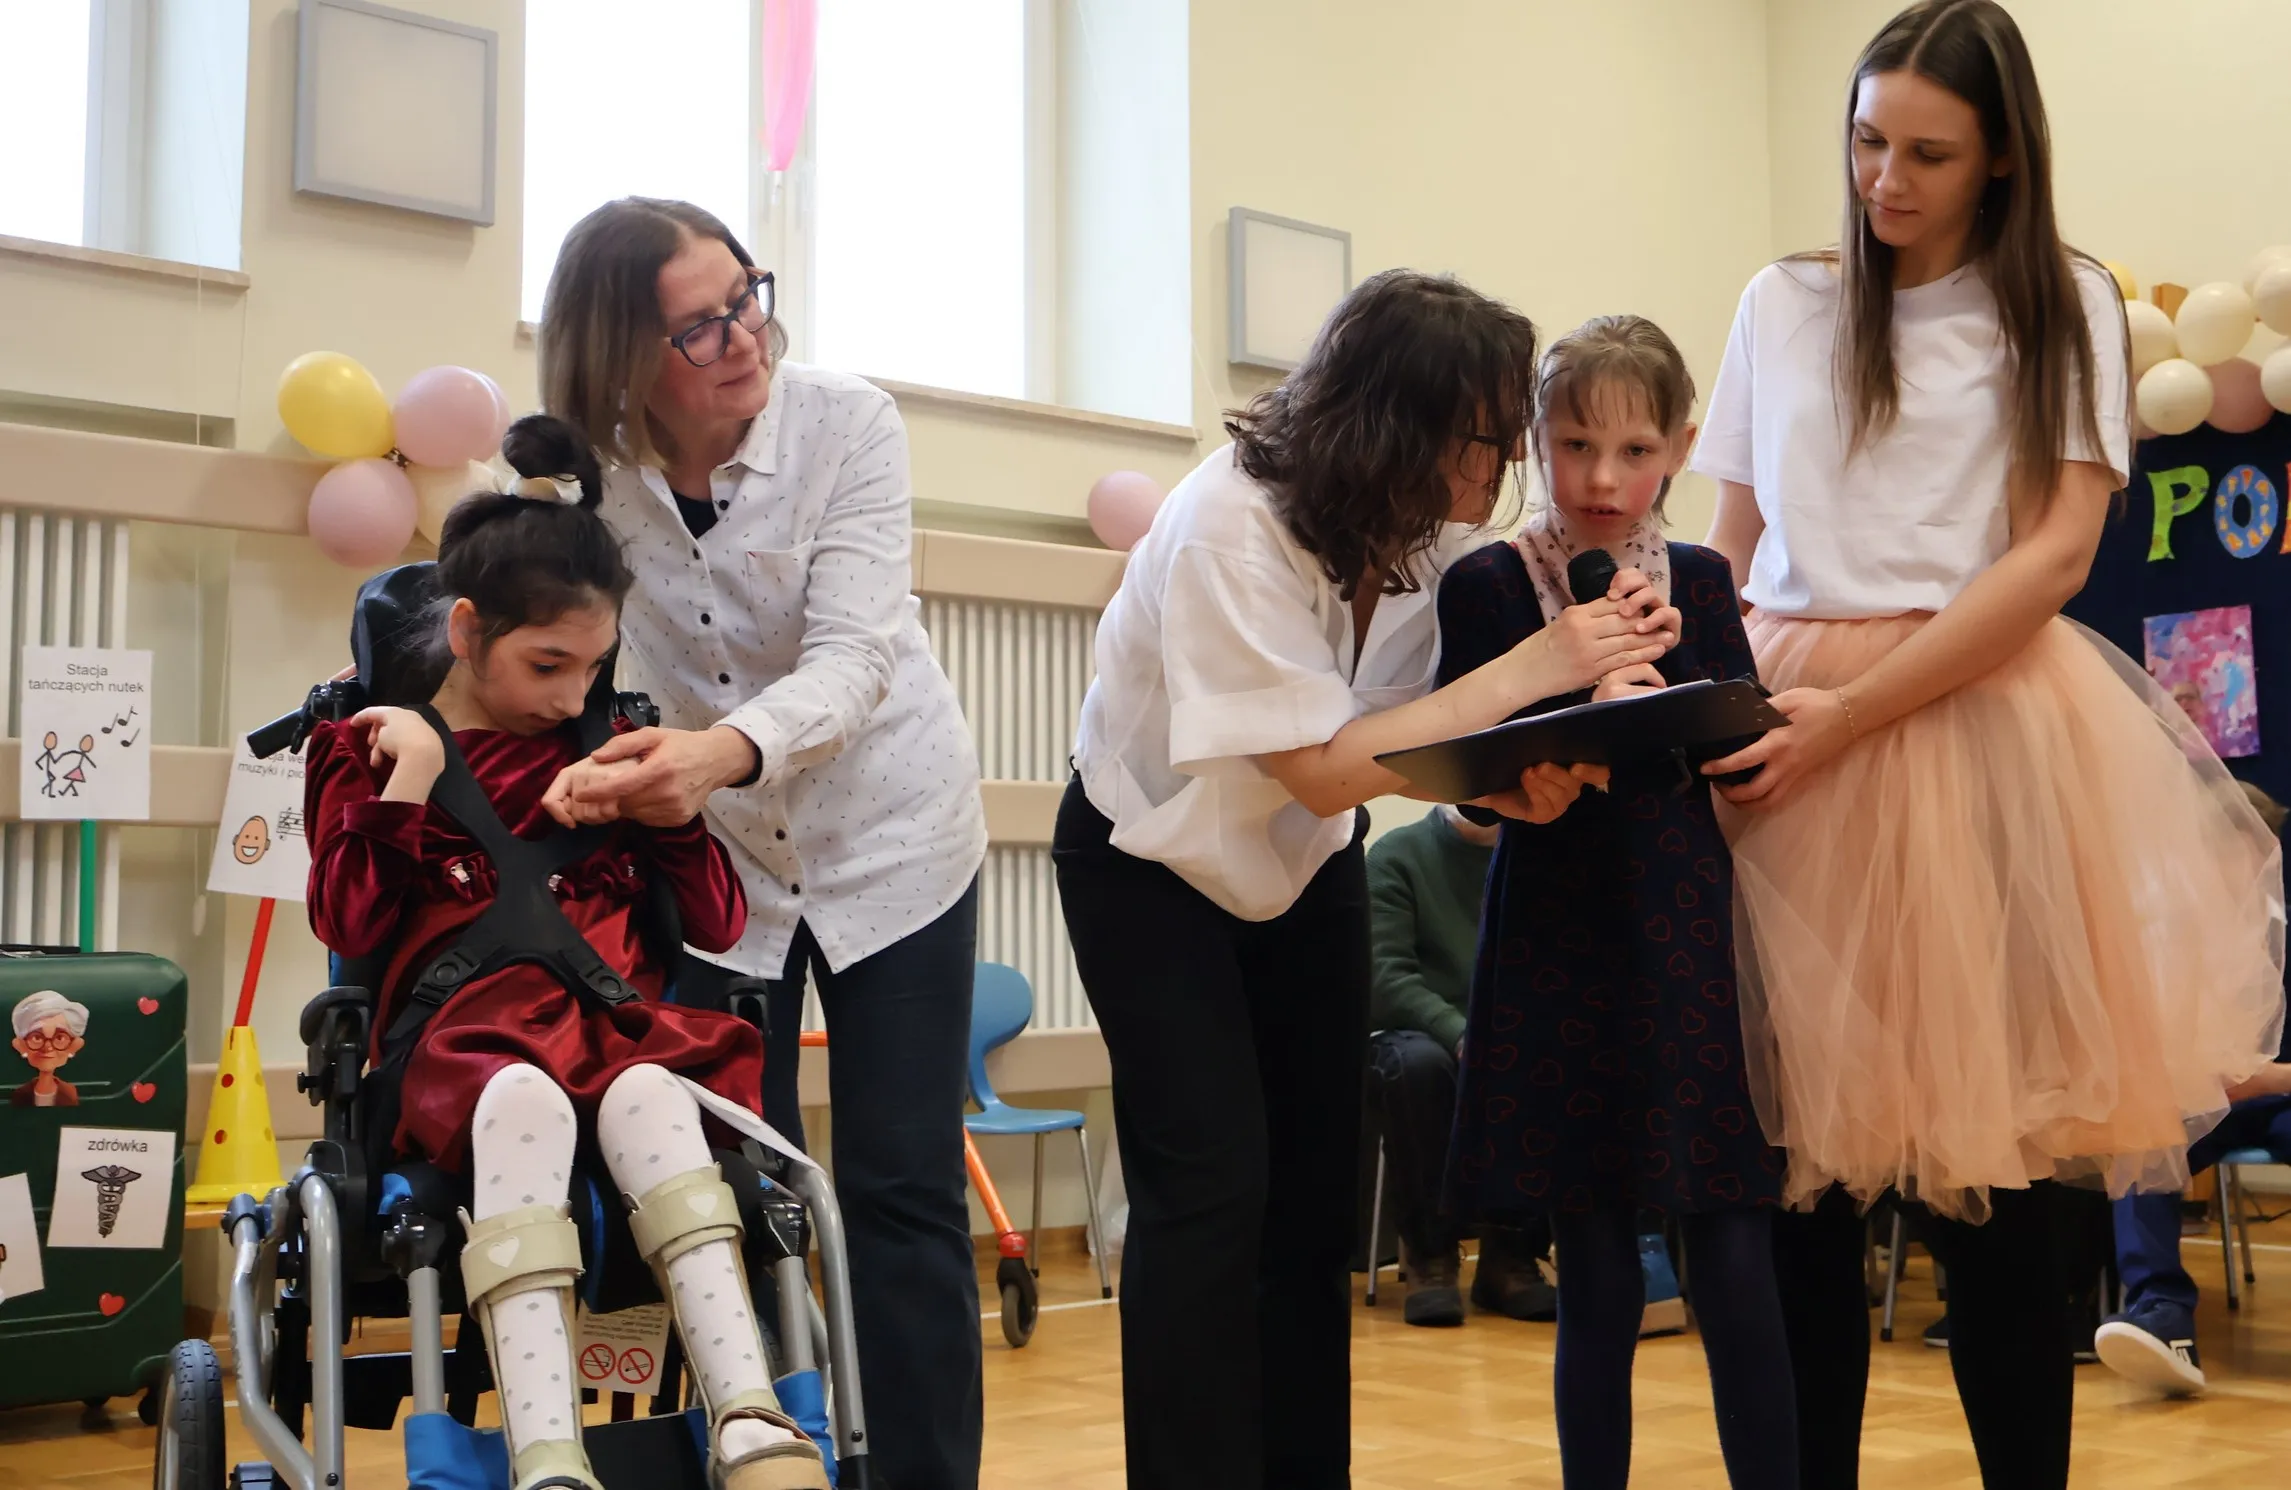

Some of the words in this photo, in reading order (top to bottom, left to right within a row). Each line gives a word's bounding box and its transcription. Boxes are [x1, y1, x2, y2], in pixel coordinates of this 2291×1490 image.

[2145, 462, 2291, 561] PO
[67, 664, 108, 678] Stacja
[28, 679, 104, 693] tańczących
[108, 681, 144, 692] nutek
[288, 753, 305, 763] we
[238, 763, 277, 777] muzyki
[287, 769, 305, 779] pio
[87, 1138, 148, 1152] zdrówka
